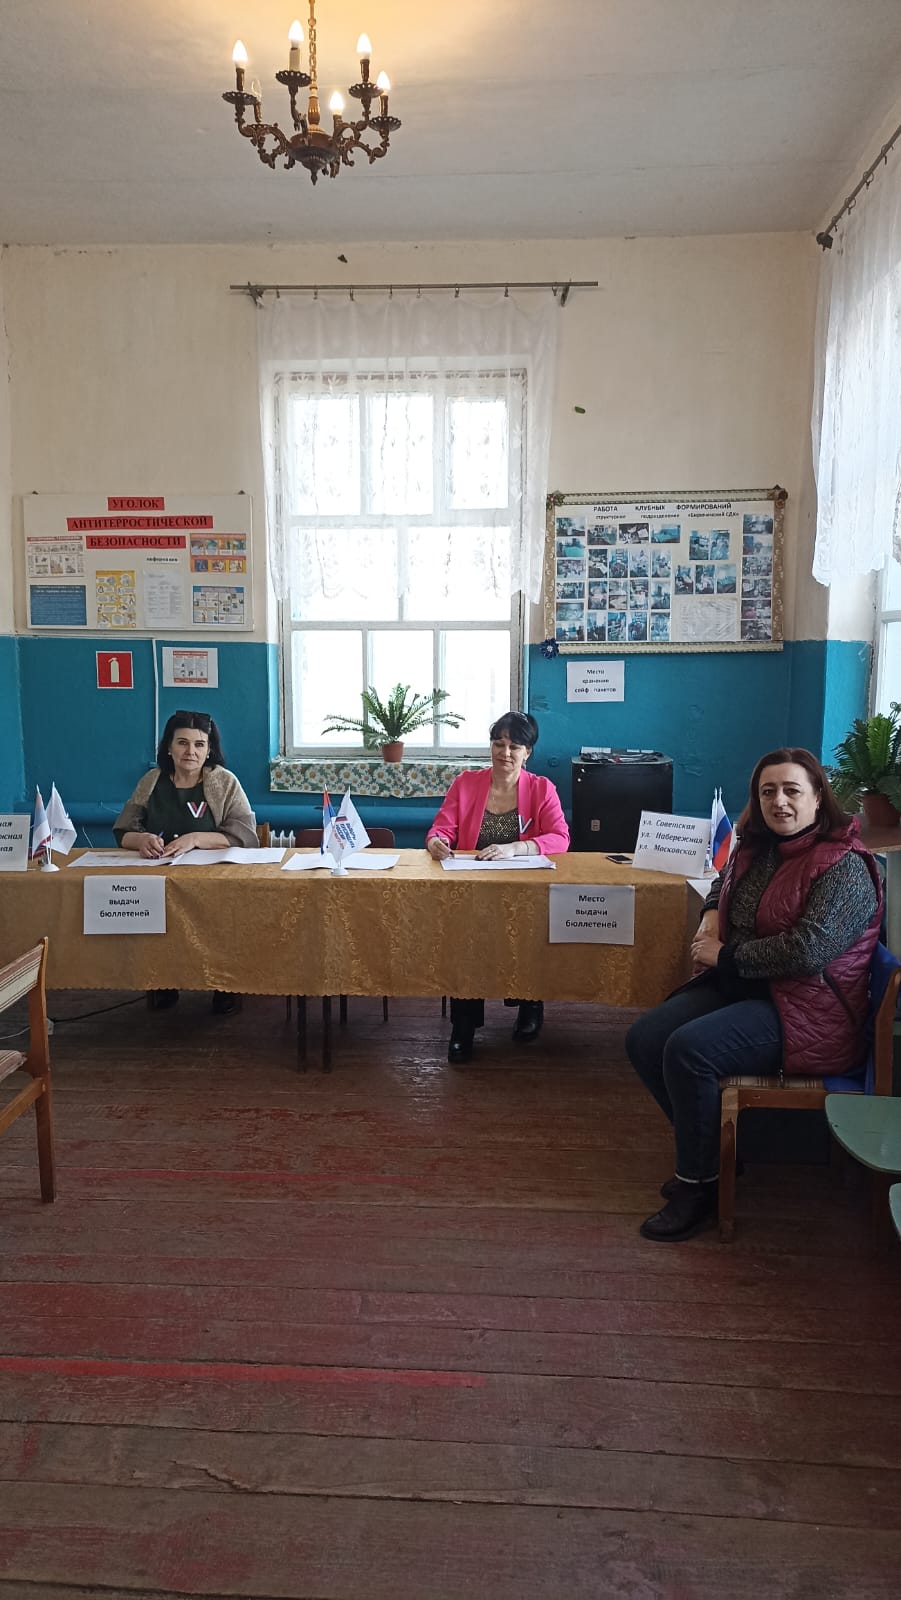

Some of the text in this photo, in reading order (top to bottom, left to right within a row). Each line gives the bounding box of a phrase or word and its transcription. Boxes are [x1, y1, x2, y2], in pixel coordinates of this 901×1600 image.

[112, 499, 159, 509] УГОЛОК
[72, 517, 207, 528] АНТИТЕРРОСТИЧЕСКОЙ
[90, 535, 181, 547] БЕЗОПАСНОСТИ
[656, 819, 696, 830] Советская
[655, 832, 703, 844] Набережная
[653, 844, 697, 856] Московская
[111, 884, 137, 892] Место
[108, 899, 140, 907] выдачи
[578, 894, 606, 903] Место
[99, 909, 150, 918] бюллетеней
[575, 908, 608, 918] выдачи
[565, 919, 617, 929] бюллетеней
